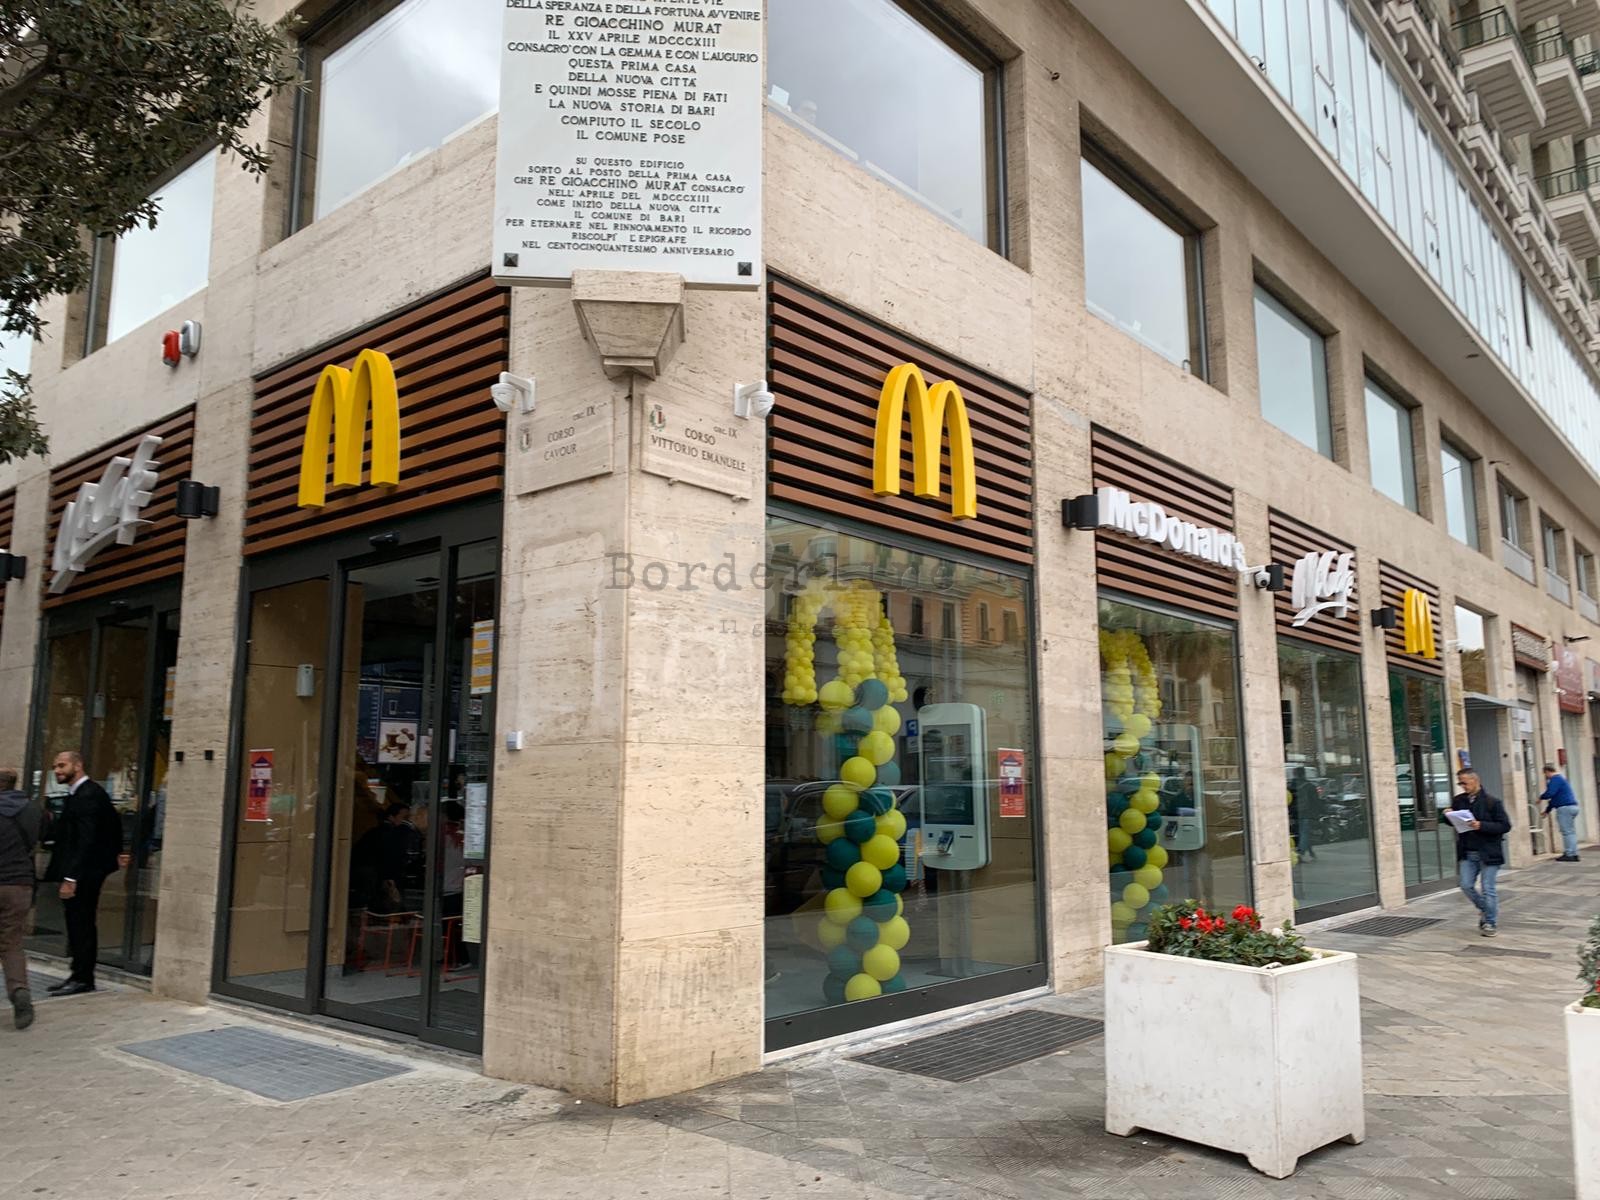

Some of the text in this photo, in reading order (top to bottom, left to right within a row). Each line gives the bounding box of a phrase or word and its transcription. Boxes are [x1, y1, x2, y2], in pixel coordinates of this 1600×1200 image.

[506, 0, 760, 21] DELLA SPERANZA E DELLA FORTUNA AVVENIRE
[545, 14, 722, 34] RE GIOACCHINO MURAT
[548, 30, 715, 47] IL XXV APRILE MDCCCXIII
[572, 45, 597, 55] CON
[600, 46, 616, 56] LA
[618, 47, 662, 59] GEMMA
[665, 50, 673, 59] E
[674, 50, 699, 60] CON
[702, 51, 758, 63] L'AUGURIO
[568, 58, 697, 74] QUESTA PRIMA CASA
[568, 72, 608, 83] DELLA
[616, 74, 654, 86] NUOVA
[535, 84, 727, 102] E QUINDI MOSSE PIENA DI FATI
[549, 99, 715, 116] LA NUOVA STORIA DI BARI
[560, 115, 701, 131] COMPIUTO IL SECOLO
[577, 130, 685, 144] IL COMUNE POSE
[576, 157, 685, 169] SU QUESTO EDIFICIO
[528, 166, 562, 176] SORTO
[589, 168, 622, 177] POSTO
[628, 170, 660, 179] DELLA
[667, 172, 698, 180] PRIMA
[705, 174, 731, 182] CASA
[539, 175, 556, 186] RE
[562, 177, 638, 189] GIOACCHINO
[645, 179, 689, 191] MURAT
[579, 190, 615, 201] APRILE
[621, 192, 641, 200] DEL
[652, 193, 709, 202] MDCCCXIII
[537, 199, 565, 207] COME
[572, 200, 603, 208] INIZIO
[610, 202, 642, 210] DELLA
[649, 204, 680, 212] NUOVA
[574, 211, 685, 223] IL COMUNE DI BARI
[531, 220, 582, 229] ETERNARE
[588, 222, 608, 230] NEL
[614, 222, 687, 234] RINNOVAMENTO
[693, 226, 703, 234] IL
[709, 227, 751, 236] RICORDO
[522, 241, 735, 256] NEL CENTOCINQUANTESIMO ANNIVERSARIO
[547, 426, 575, 442] CORSO
[685, 428, 716, 445] CORSO
[543, 443, 577, 461] CAVOUR
[651, 434, 746, 471] VITTORIO EMANUELE
